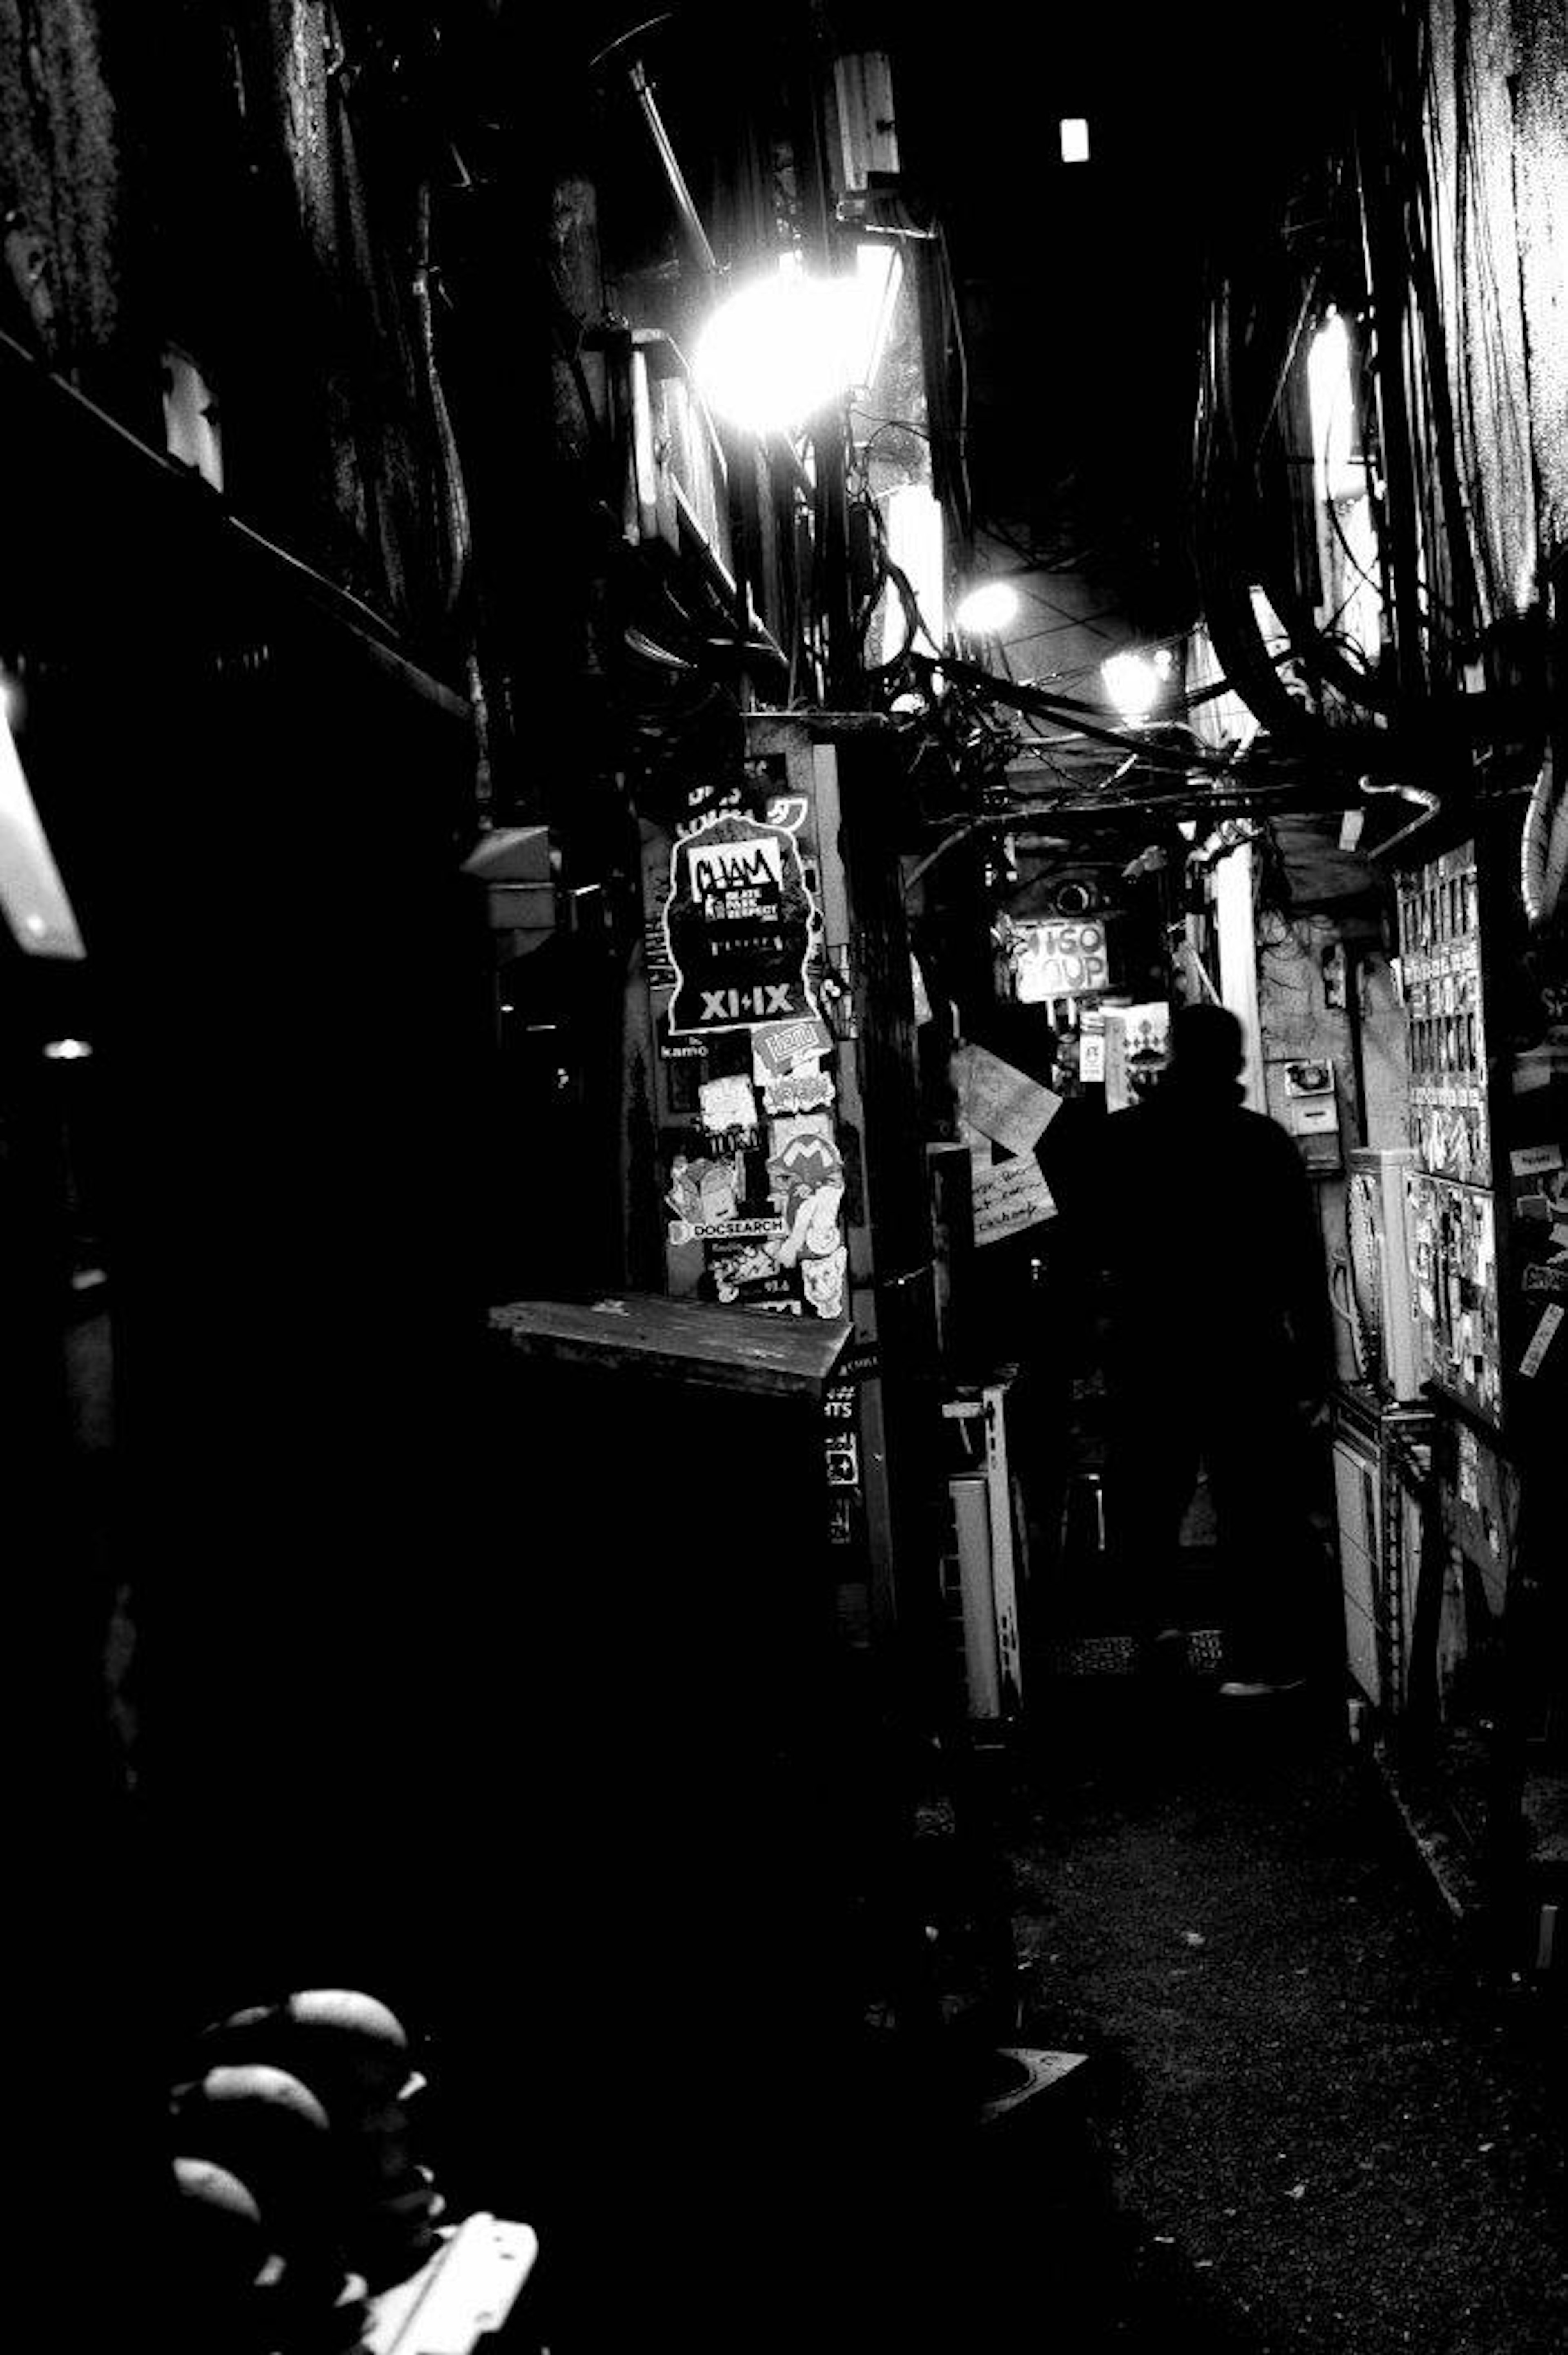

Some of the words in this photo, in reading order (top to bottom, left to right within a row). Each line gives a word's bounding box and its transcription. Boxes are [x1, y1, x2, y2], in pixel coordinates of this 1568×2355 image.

[1022, 957, 1103, 988] OUP
[660, 1045, 709, 1059] kamo
[695, 1221, 782, 1235] DOCSEARCH
